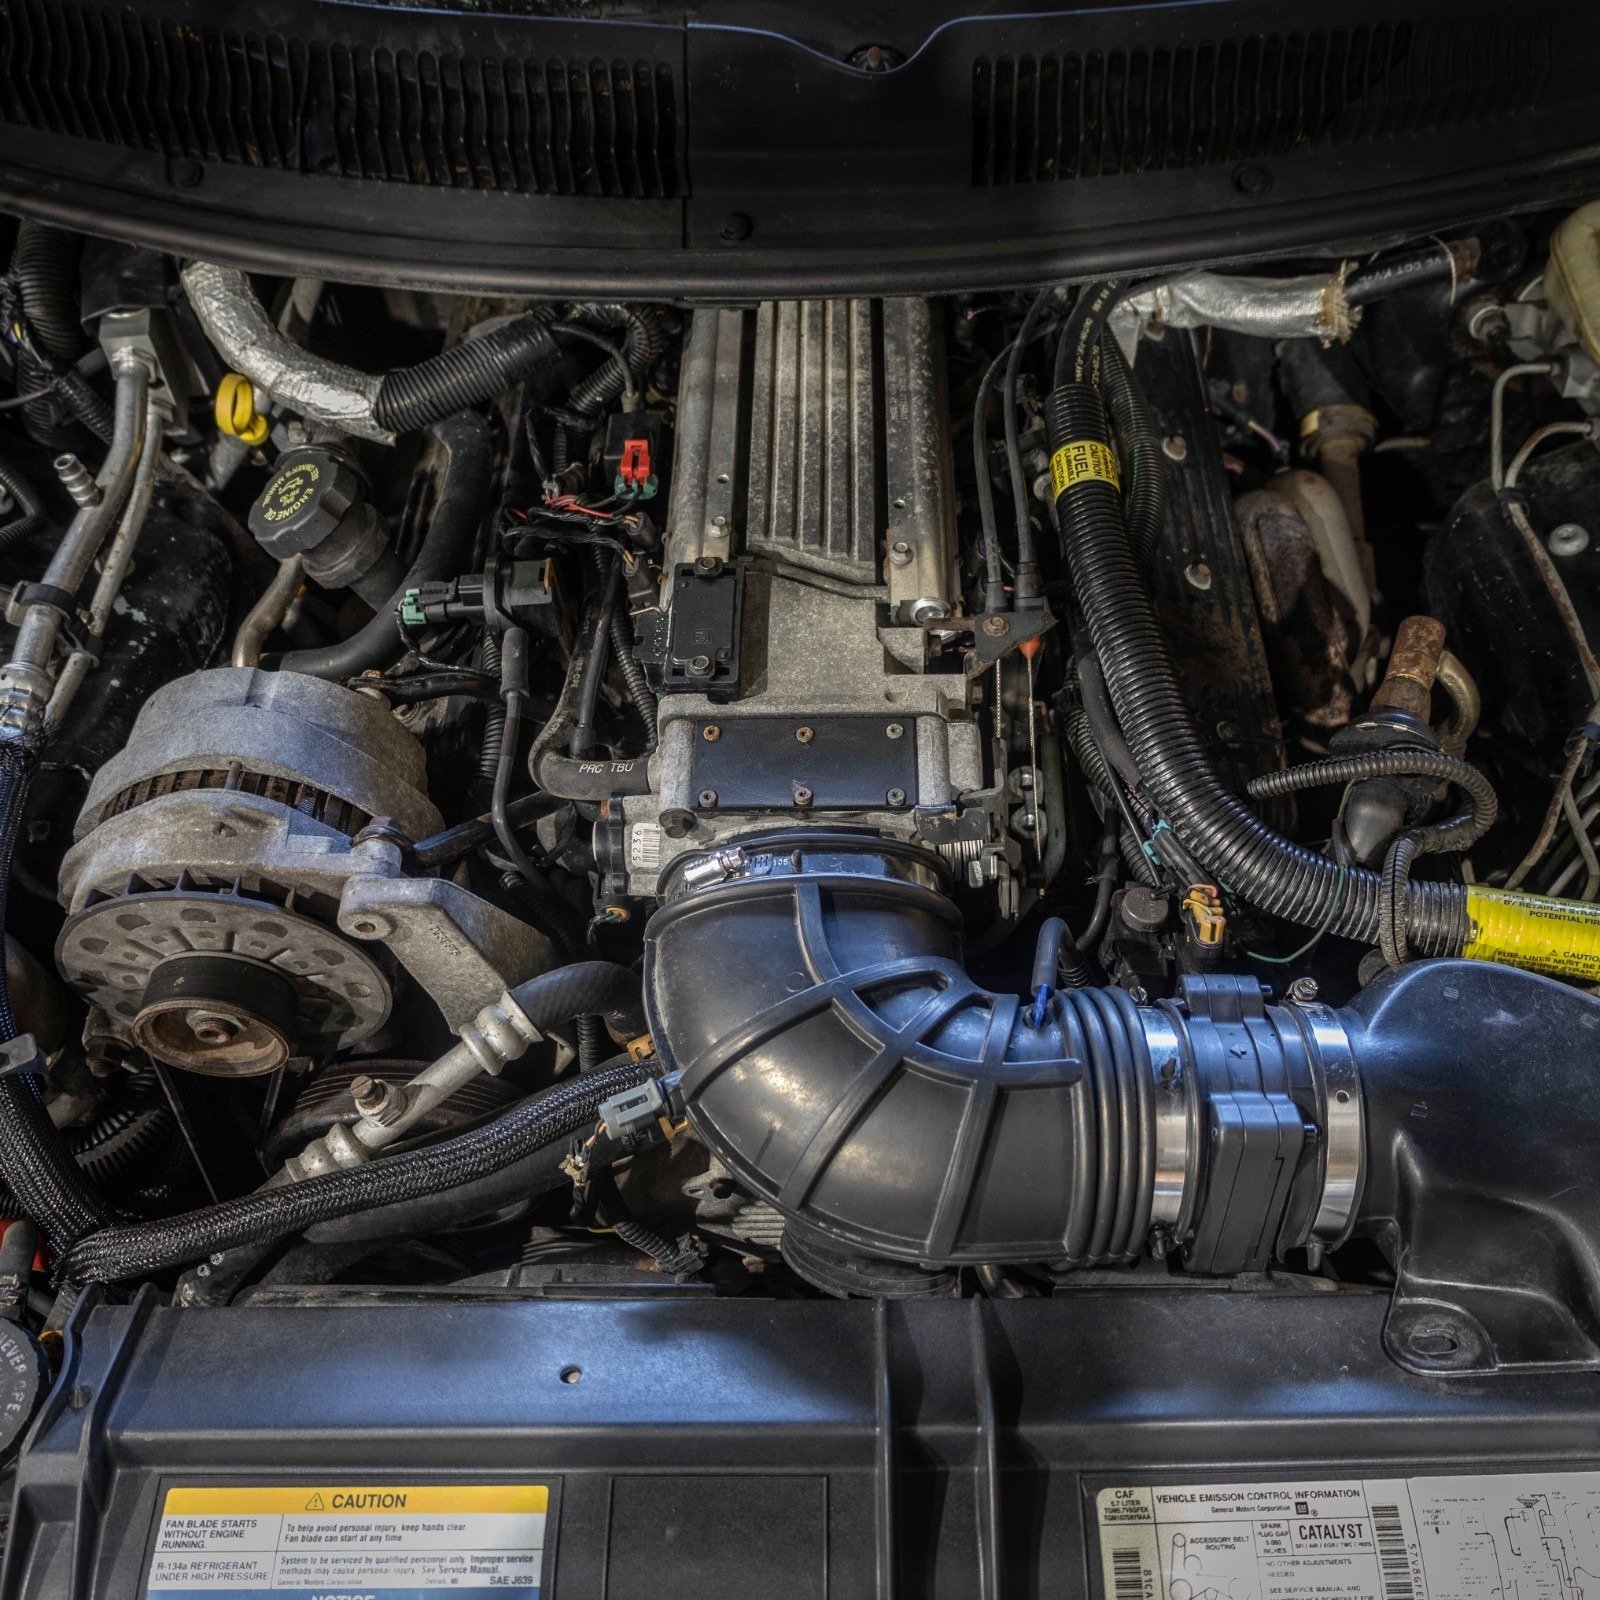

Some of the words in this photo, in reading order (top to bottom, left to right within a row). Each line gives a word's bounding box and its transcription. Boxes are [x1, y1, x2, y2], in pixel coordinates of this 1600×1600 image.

[1064, 447, 1076, 482] FLAMMABLE
[1072, 445, 1089, 478] FUEL
[1089, 444, 1103, 477] CAUTION
[1054, 453, 1066, 489] CAUTION
[275, 488, 313, 520] ENGINE
[264, 508, 277, 520] OIL
[611, 762, 634, 772] TBU
[632, 829, 643, 862] 5236
[1529, 911, 1583, 924] POTENTIAL
[1497, 950, 1520, 959] FUEL
[1553, 958, 1581, 967] MUST
[1563, 951, 1600, 963] CAUTIO
[1115, 1490, 1134, 1499] CAF
[1156, 1494, 1197, 1503] VEHICLE
[1199, 1492, 1244, 1502] EMISSION
[1247, 1491, 1292, 1500] CONTROL
[1295, 1489, 1360, 1499] INFORMATION
[332, 1494, 407, 1509] CAUTION
[165, 1520, 185, 1528] FAN
[187, 1520, 219, 1528] BLADE
[221, 1519, 257, 1528] STARTS
[287, 1524, 295, 1532] To
[298, 1524, 313, 1532] help
[316, 1524, 337, 1532] avoid
[339, 1524, 372, 1533] personal
[401, 1523, 419, 1532] keep
[422, 1523, 444, 1531] hands
[164, 1530, 207, 1538] WITHOUT
[210, 1530, 245, 1538] ENGINE
[1298, 1523, 1363, 1540] CATALYST
[285, 1534, 299, 1542] Fan
[301, 1534, 322, 1542] blade
[340, 1534, 357, 1542] start
[157, 1562, 188, 1570] R-134a
[190, 1561, 258, 1570] REFRIGERANT
[281, 1556, 308, 1565] System
[320, 1556, 328, 1564] be
[331, 1556, 362, 1564] serviced
[365, 1556, 373, 1565] by
[375, 1556, 408, 1565] qualified
[409, 1556, 447, 1564] personnel
[470, 1555, 504, 1564] Improper
[506, 1555, 534, 1563] service
[279, 1567, 312, 1575] methods
[357, 1567, 391, 1575] personal
[422, 1566, 436, 1574] See
[439, 1565, 467, 1574] Service
[1408, 1543, 1424, 1600] 57V8GFE
[155, 1573, 188, 1581] UNDER
[191, 1572, 214, 1581] HIGH
[217, 1572, 268, 1580] PRESSURE
[490, 1576, 509, 1585] SAE
[511, 1576, 533, 1585] J639
